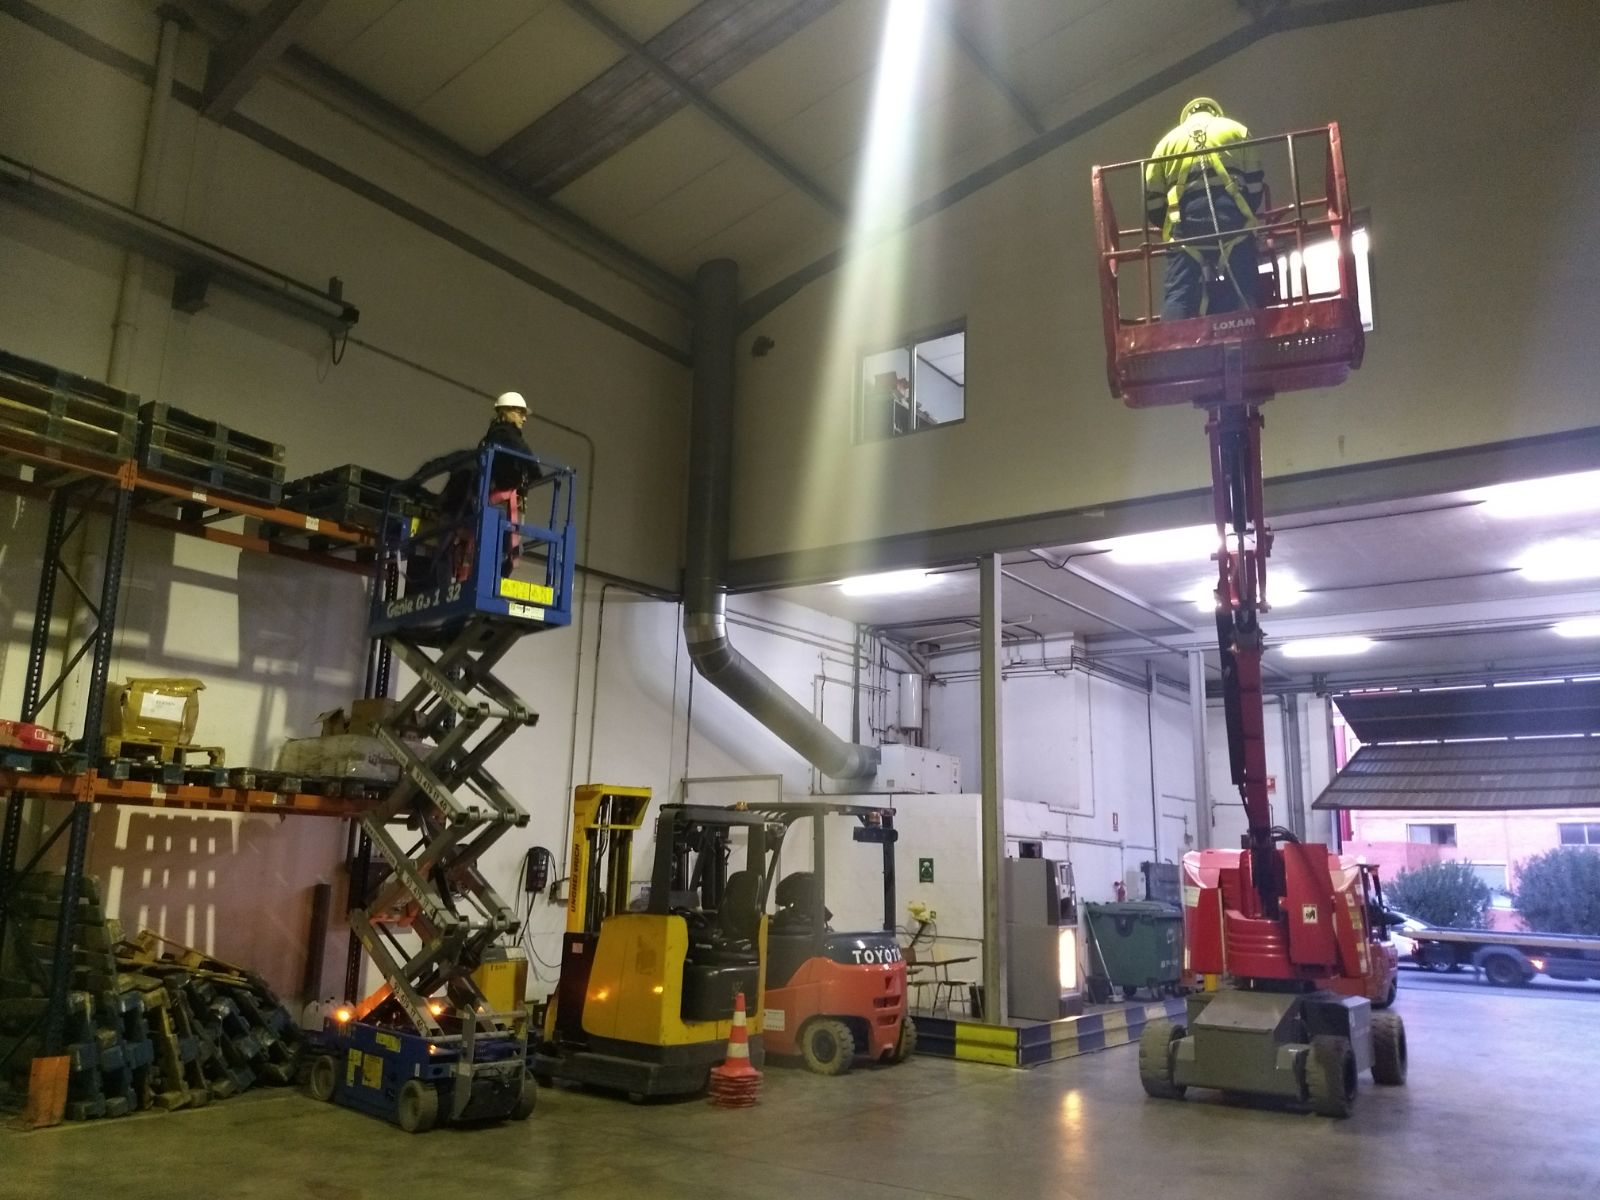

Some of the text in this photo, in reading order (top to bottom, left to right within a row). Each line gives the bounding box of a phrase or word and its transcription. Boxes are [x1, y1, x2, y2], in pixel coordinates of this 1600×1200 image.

[1213, 317, 1256, 331] LOXAM
[387, 598, 413, 618] Genie
[852, 949, 902, 964] TOYOTA
